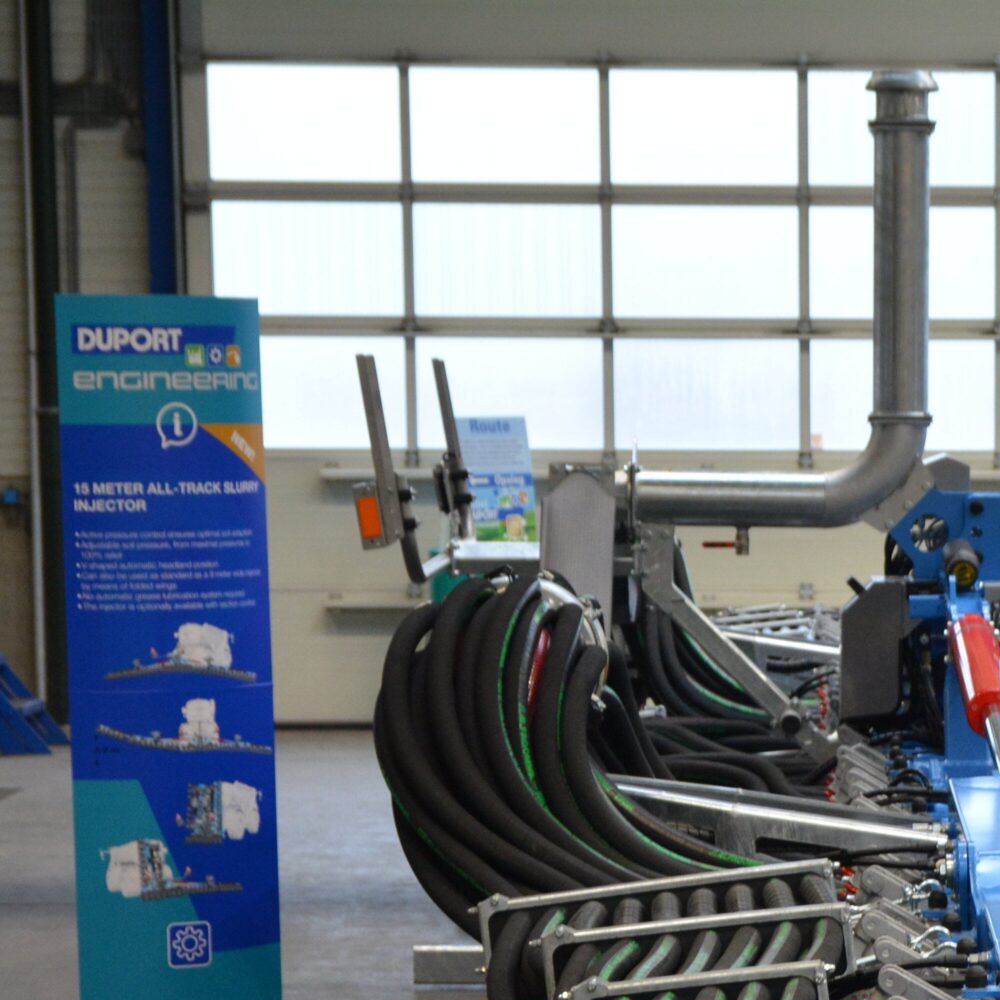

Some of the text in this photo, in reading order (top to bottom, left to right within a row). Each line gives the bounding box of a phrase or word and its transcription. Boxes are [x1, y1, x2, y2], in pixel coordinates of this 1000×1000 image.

[77, 327, 183, 352] DUPORT
[469, 418, 511, 434] Route
[74, 480, 259, 496] 15 METER ALL-TRACK SLURRY
[73, 498, 147, 513] INJECTOR
